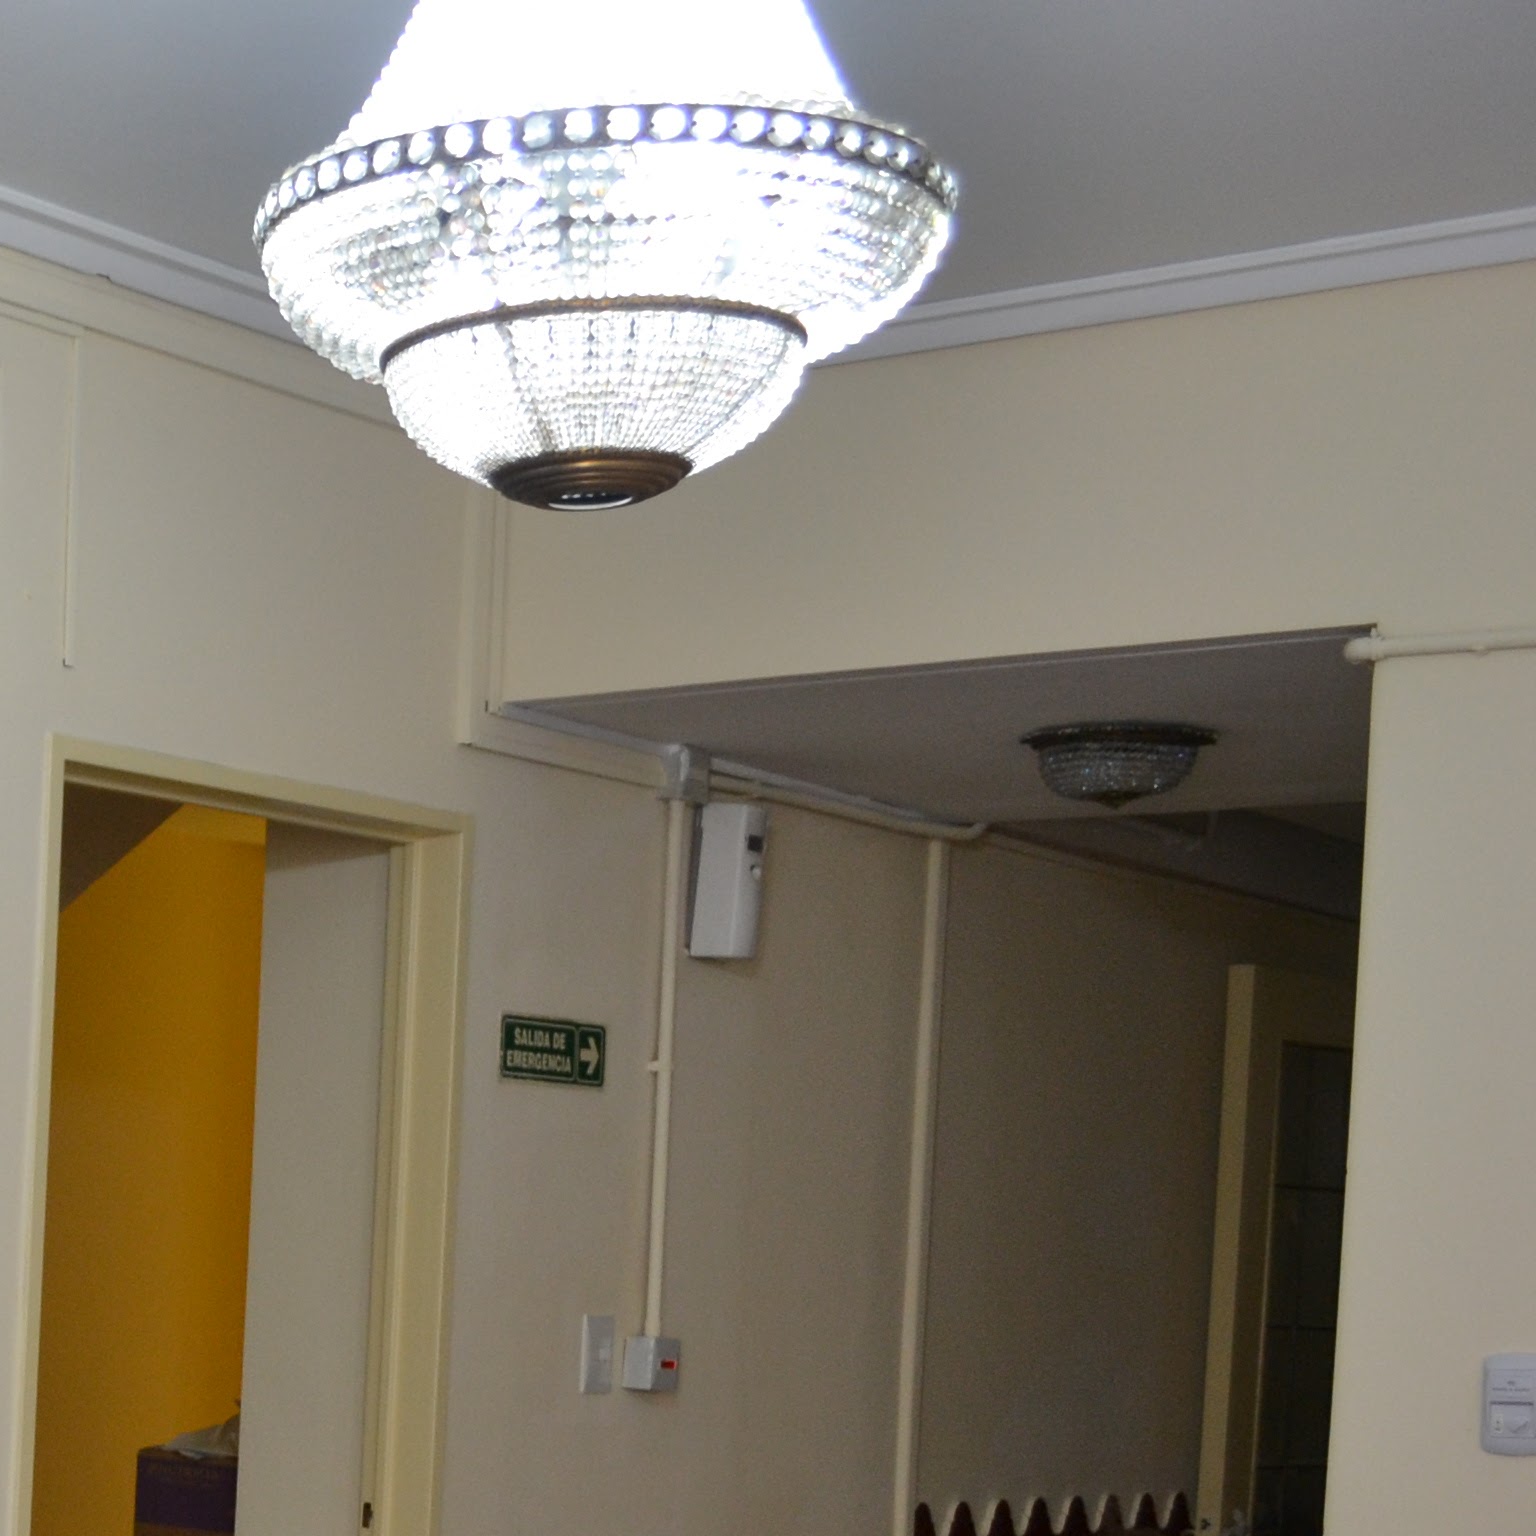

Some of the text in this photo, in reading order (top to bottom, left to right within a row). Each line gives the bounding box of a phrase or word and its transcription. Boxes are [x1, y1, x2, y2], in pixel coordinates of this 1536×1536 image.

[514, 1027, 567, 1050] SALIDA DE
[506, 1050, 572, 1073] EMERGENCIA
